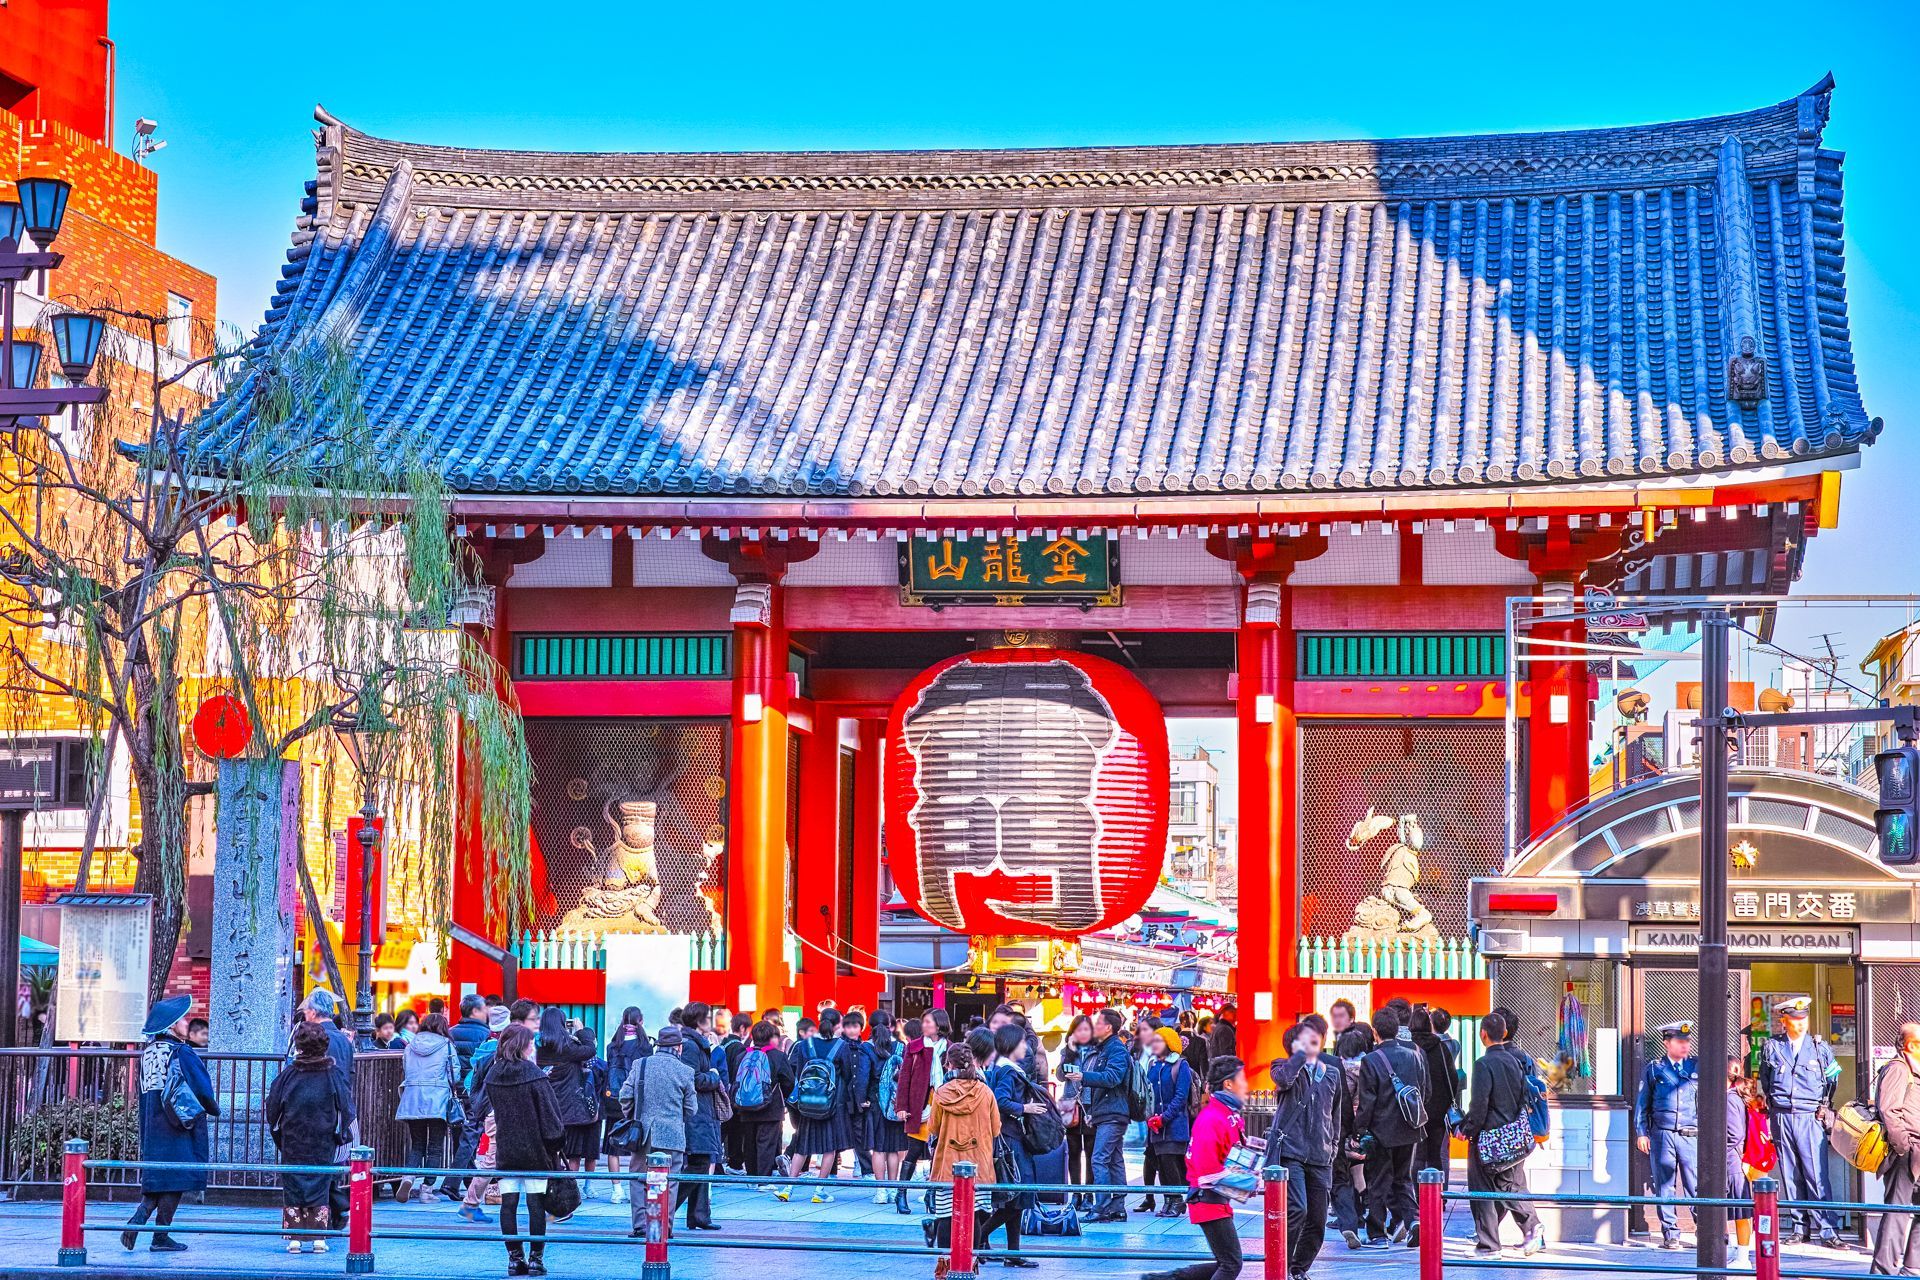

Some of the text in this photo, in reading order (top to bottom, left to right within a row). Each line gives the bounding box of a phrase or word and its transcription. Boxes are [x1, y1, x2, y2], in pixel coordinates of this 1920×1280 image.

[903, 659, 1121, 930] 雷門
[1635, 891, 1857, 919] 浅草警察 雷門交番
[1647, 933, 1840, 948] KAMINIMON KOBAN
